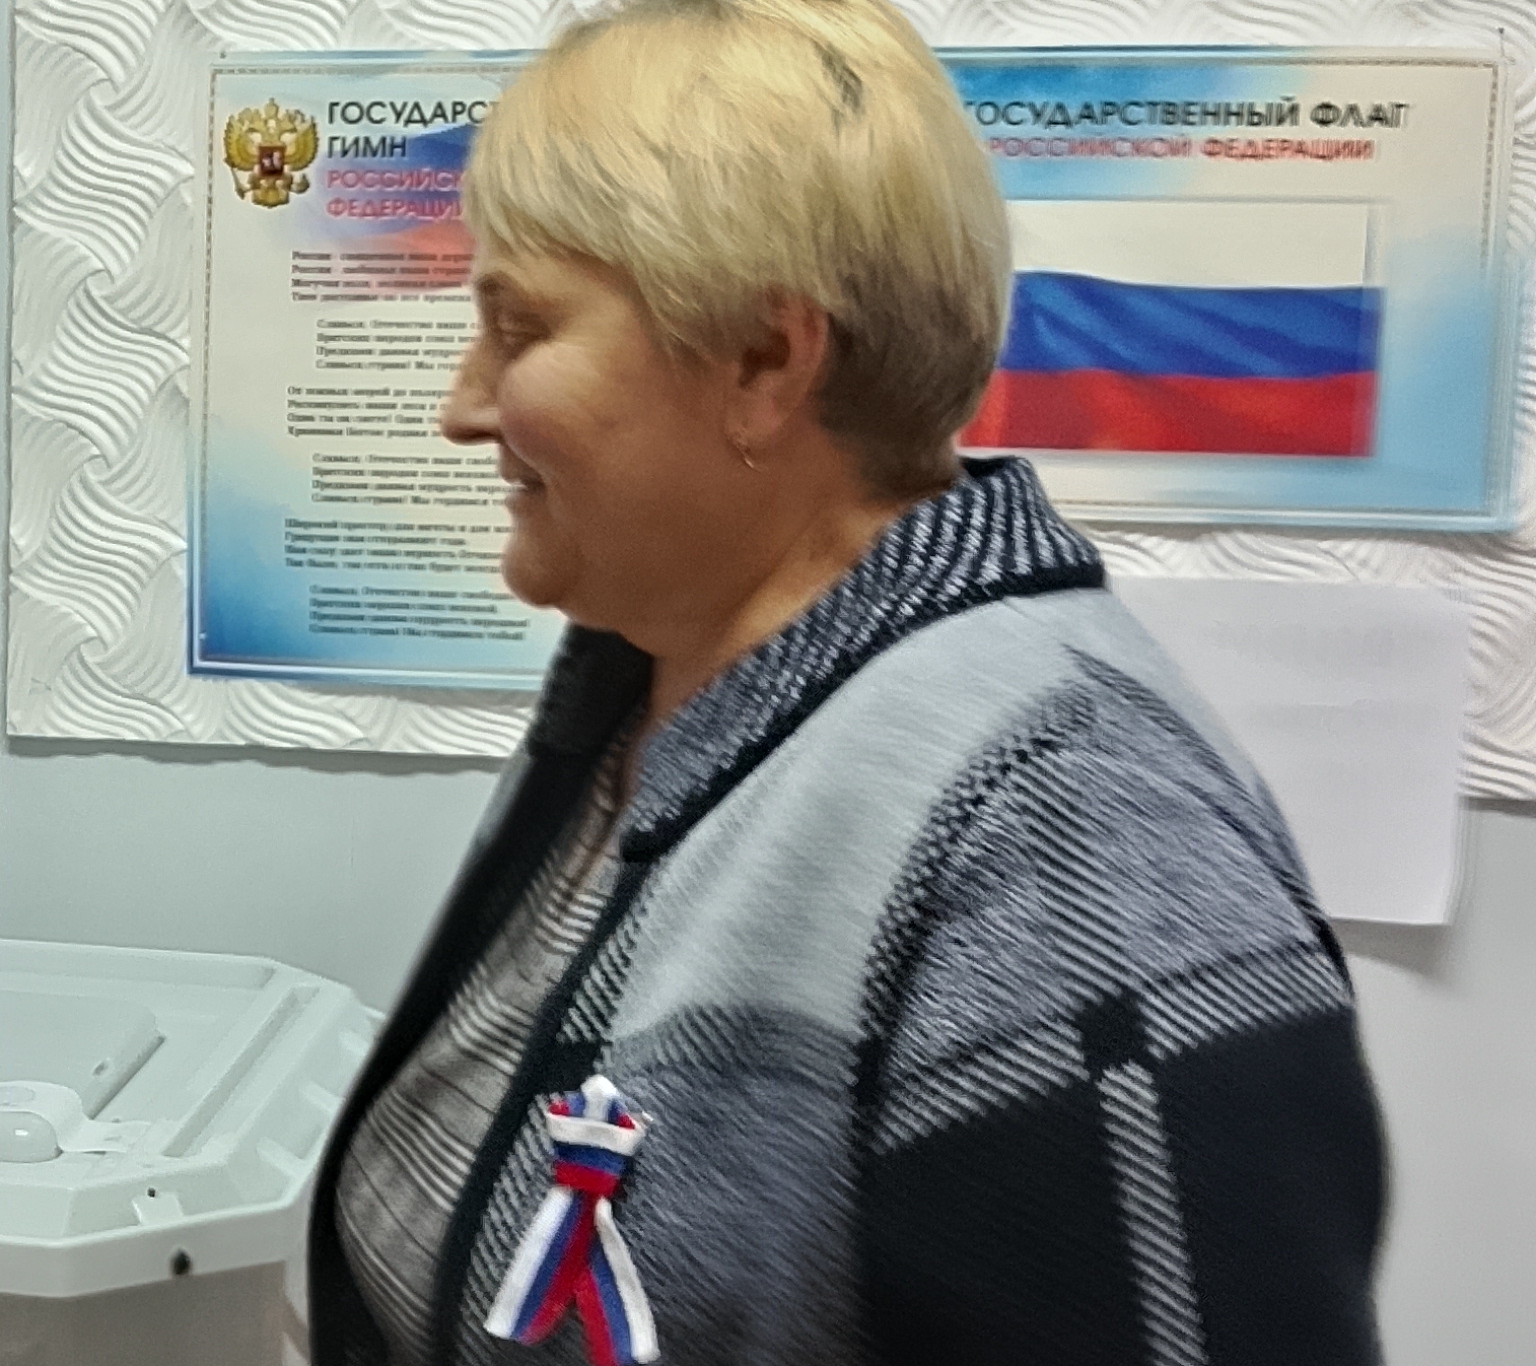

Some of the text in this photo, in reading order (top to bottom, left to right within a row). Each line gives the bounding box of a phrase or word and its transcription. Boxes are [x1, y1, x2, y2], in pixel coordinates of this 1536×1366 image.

[328, 101, 500, 128] ГОСУДАРС
[965, 95, 1410, 129] ОСУДАРСТВЕННЫЙ ФЛАГ
[328, 136, 407, 158] ГИМН
[1200, 138, 1375, 160] ФЕДЕРАЦИИ
